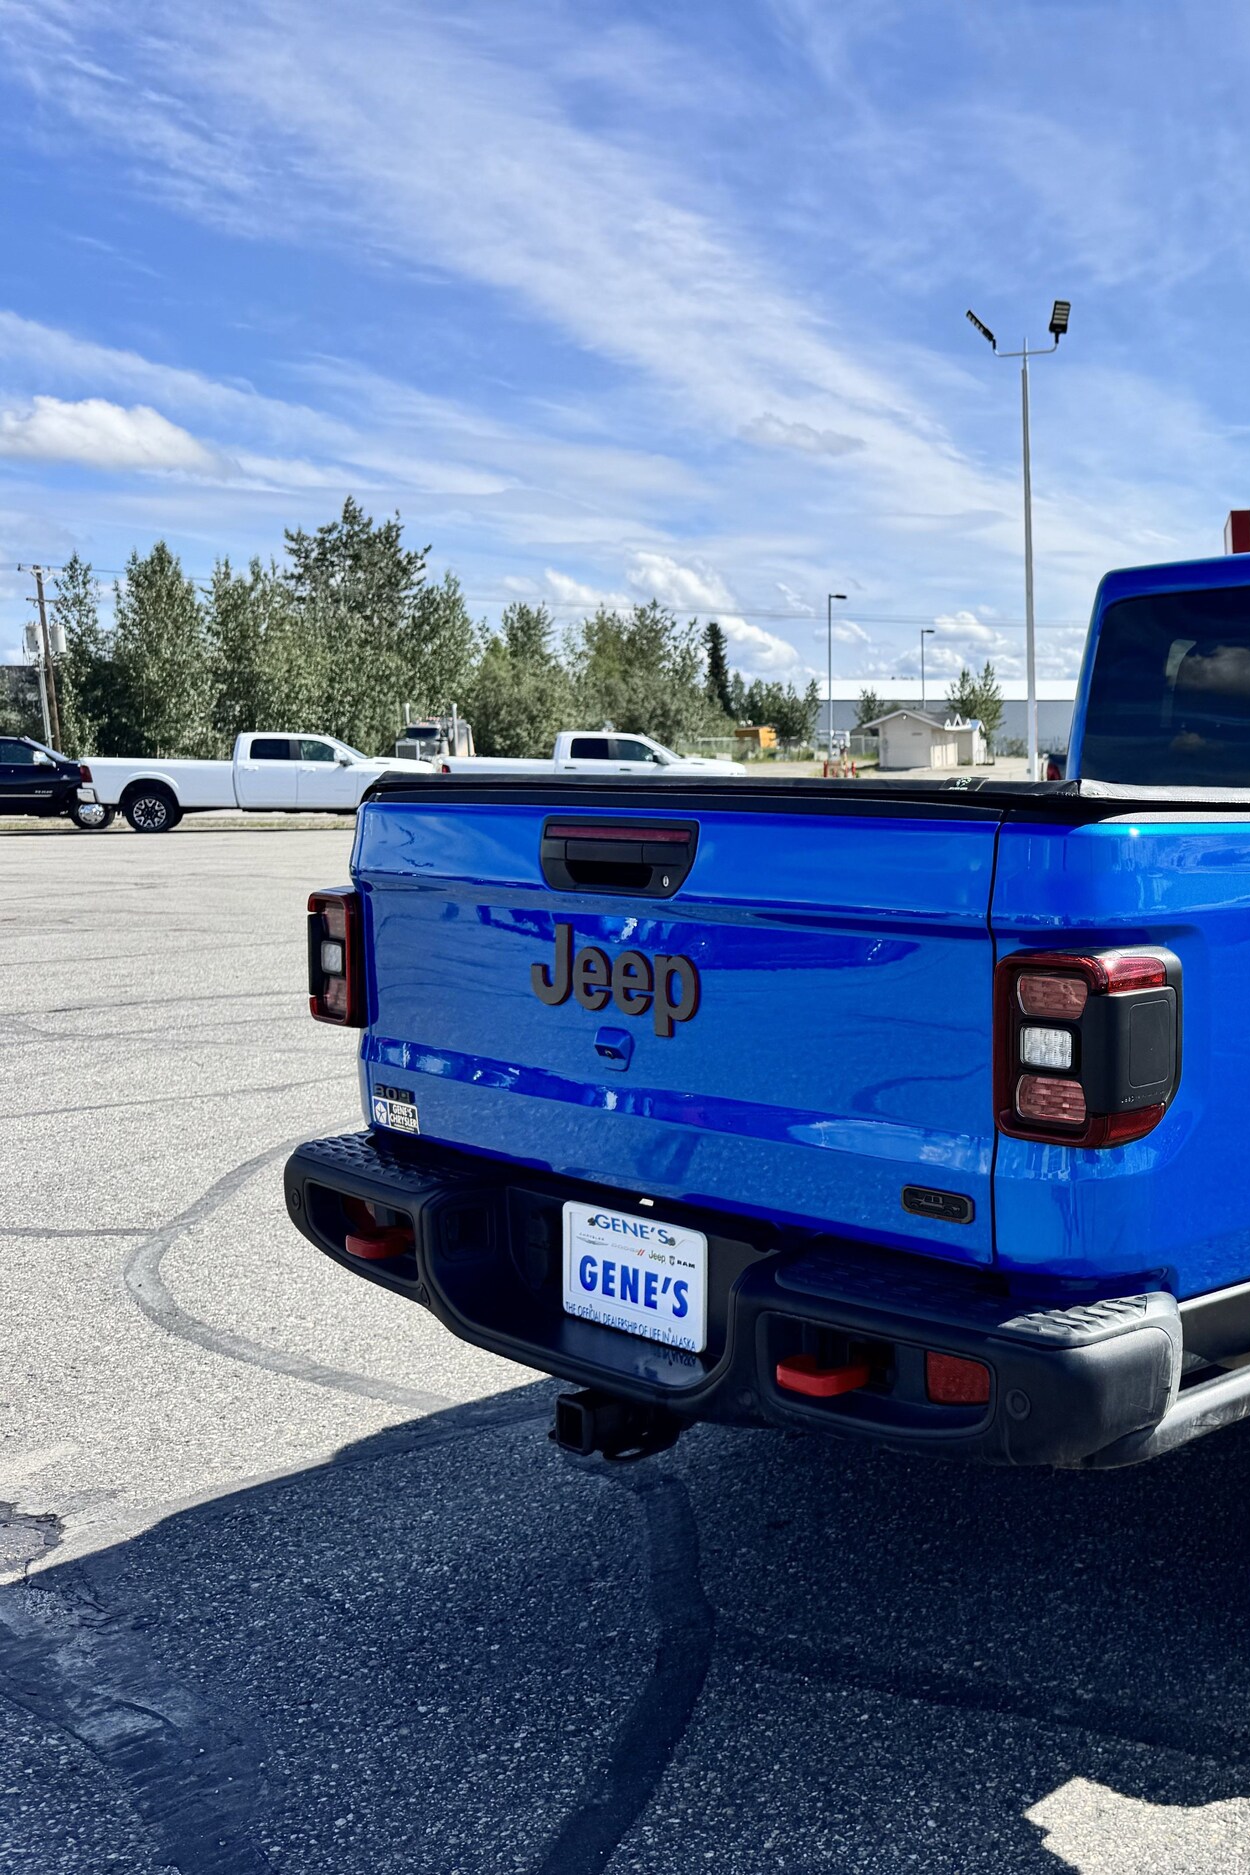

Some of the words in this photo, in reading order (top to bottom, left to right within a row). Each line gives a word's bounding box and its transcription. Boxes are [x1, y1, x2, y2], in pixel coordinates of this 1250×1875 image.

[530, 922, 699, 1037] Jeep
[594, 1214, 669, 1245] GENE'S
[649, 1250, 666, 1264] Jeep
[676, 1260, 696, 1269] RAM
[579, 1255, 689, 1319] GENE'S
[565, 1301, 576, 1315] THE
[577, 1305, 601, 1322] OFFICIAL
[602, 1312, 638, 1333] DEALERSHIP
[638, 1324, 648, 1336] OF
[649, 1327, 661, 1341] LIFE
[662, 1331, 670, 1343] IN
[670, 1333, 696, 1351] ALASKA
